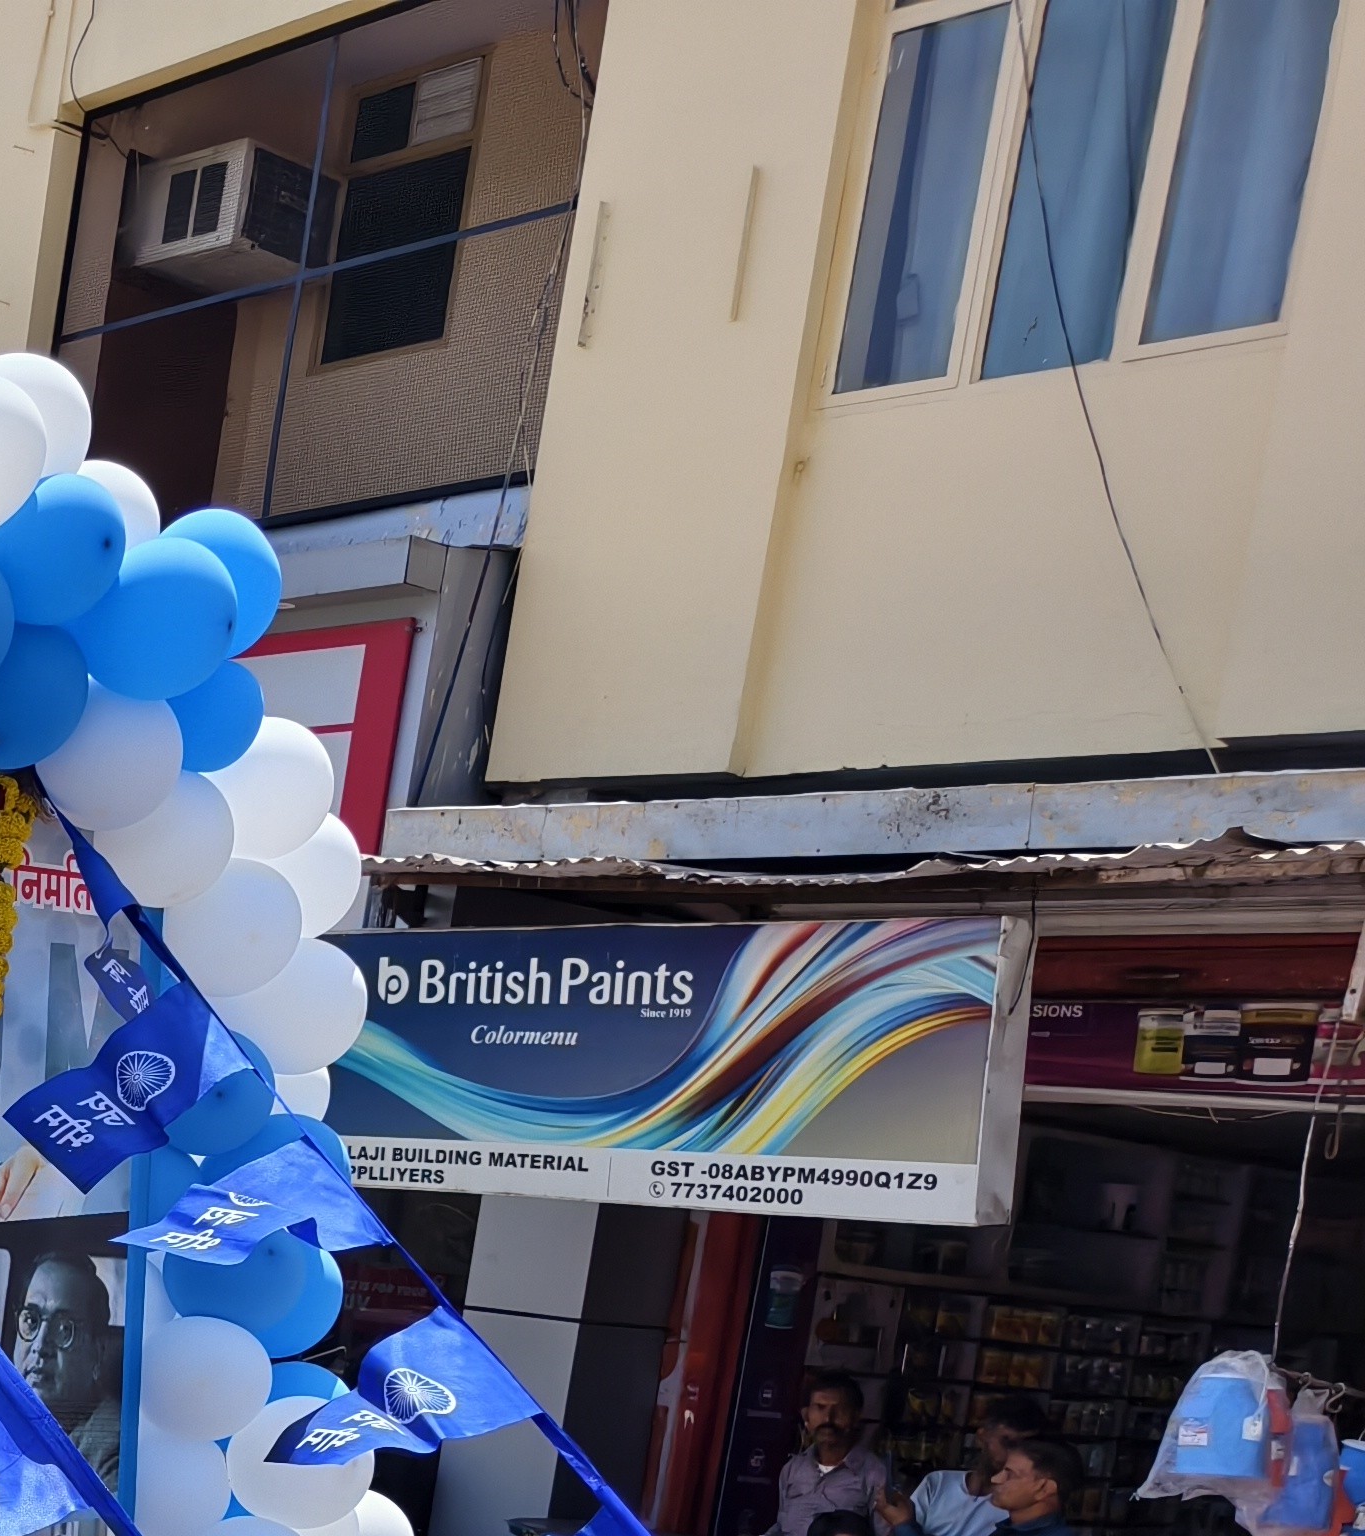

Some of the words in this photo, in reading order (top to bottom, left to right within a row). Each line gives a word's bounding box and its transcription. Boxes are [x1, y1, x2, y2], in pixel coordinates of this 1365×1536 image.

[419, 957, 552, 1005] British
[560, 957, 694, 1006] Paints
[640, 1008, 666, 1018] Since
[668, 1008, 692, 1018] 1919
[1030, 1004, 1084, 1018] SIONS
[470, 1024, 580, 1047] Colormenu
[347, 1146, 386, 1162] LAJI
[392, 1147, 483, 1167] BUILDING
[488, 1150, 590, 1173] MATERIAL
[350, 1164, 446, 1185] PPLLIYERS
[651, 1160, 695, 1179] GST
[700, 1162, 939, 1192] -08ABYPM4990Q1Z9
[670, 1182, 804, 1206] 7737402000
